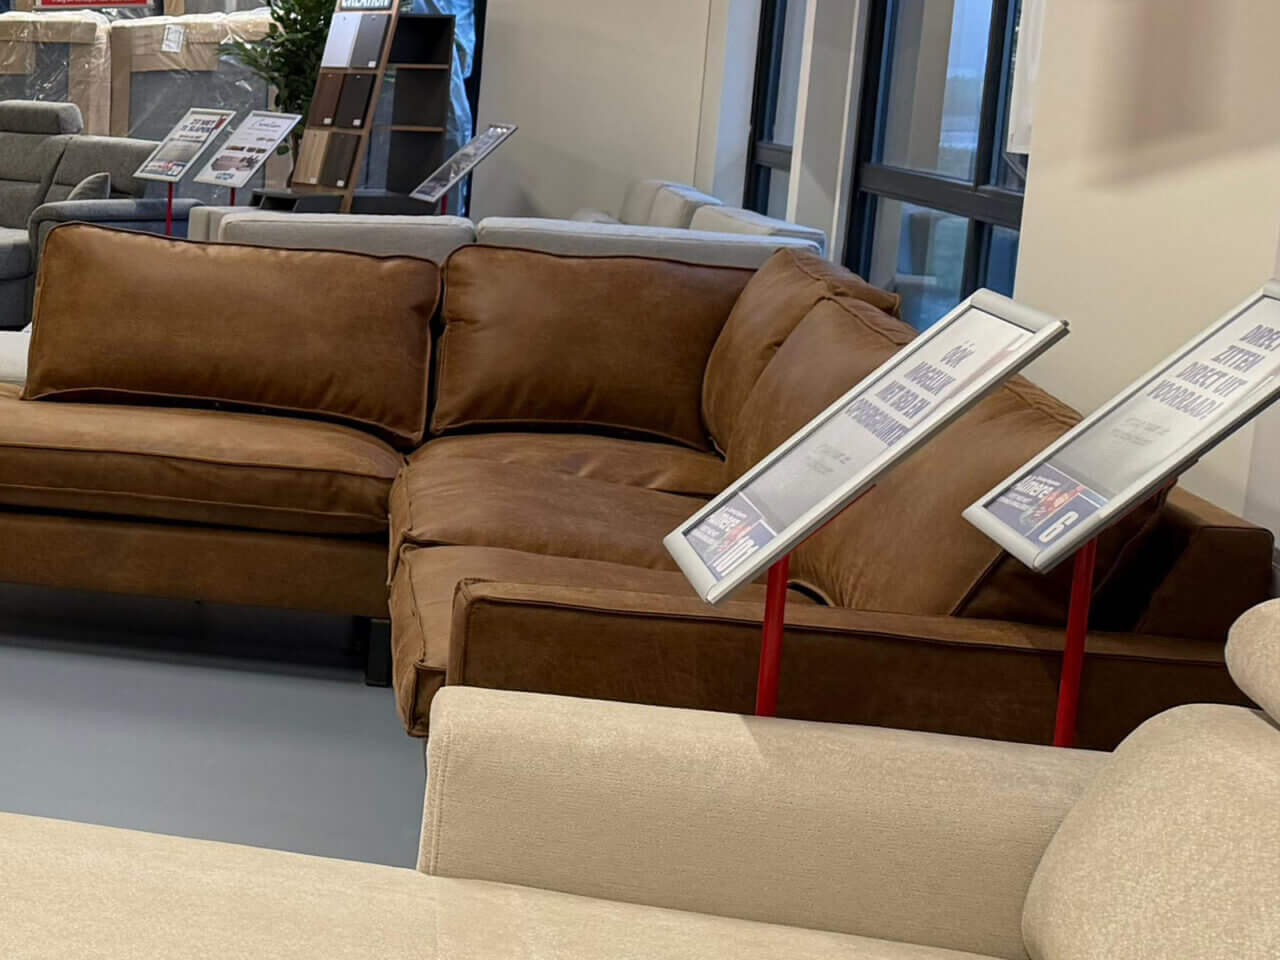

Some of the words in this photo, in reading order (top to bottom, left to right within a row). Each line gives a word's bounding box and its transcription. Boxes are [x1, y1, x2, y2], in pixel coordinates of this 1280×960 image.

[1211, 344, 1266, 373] ZITTEN
[1175, 361, 1229, 389] DIRECT
[1212, 375, 1248, 398] UIT
[1038, 511, 1080, 543] 6
